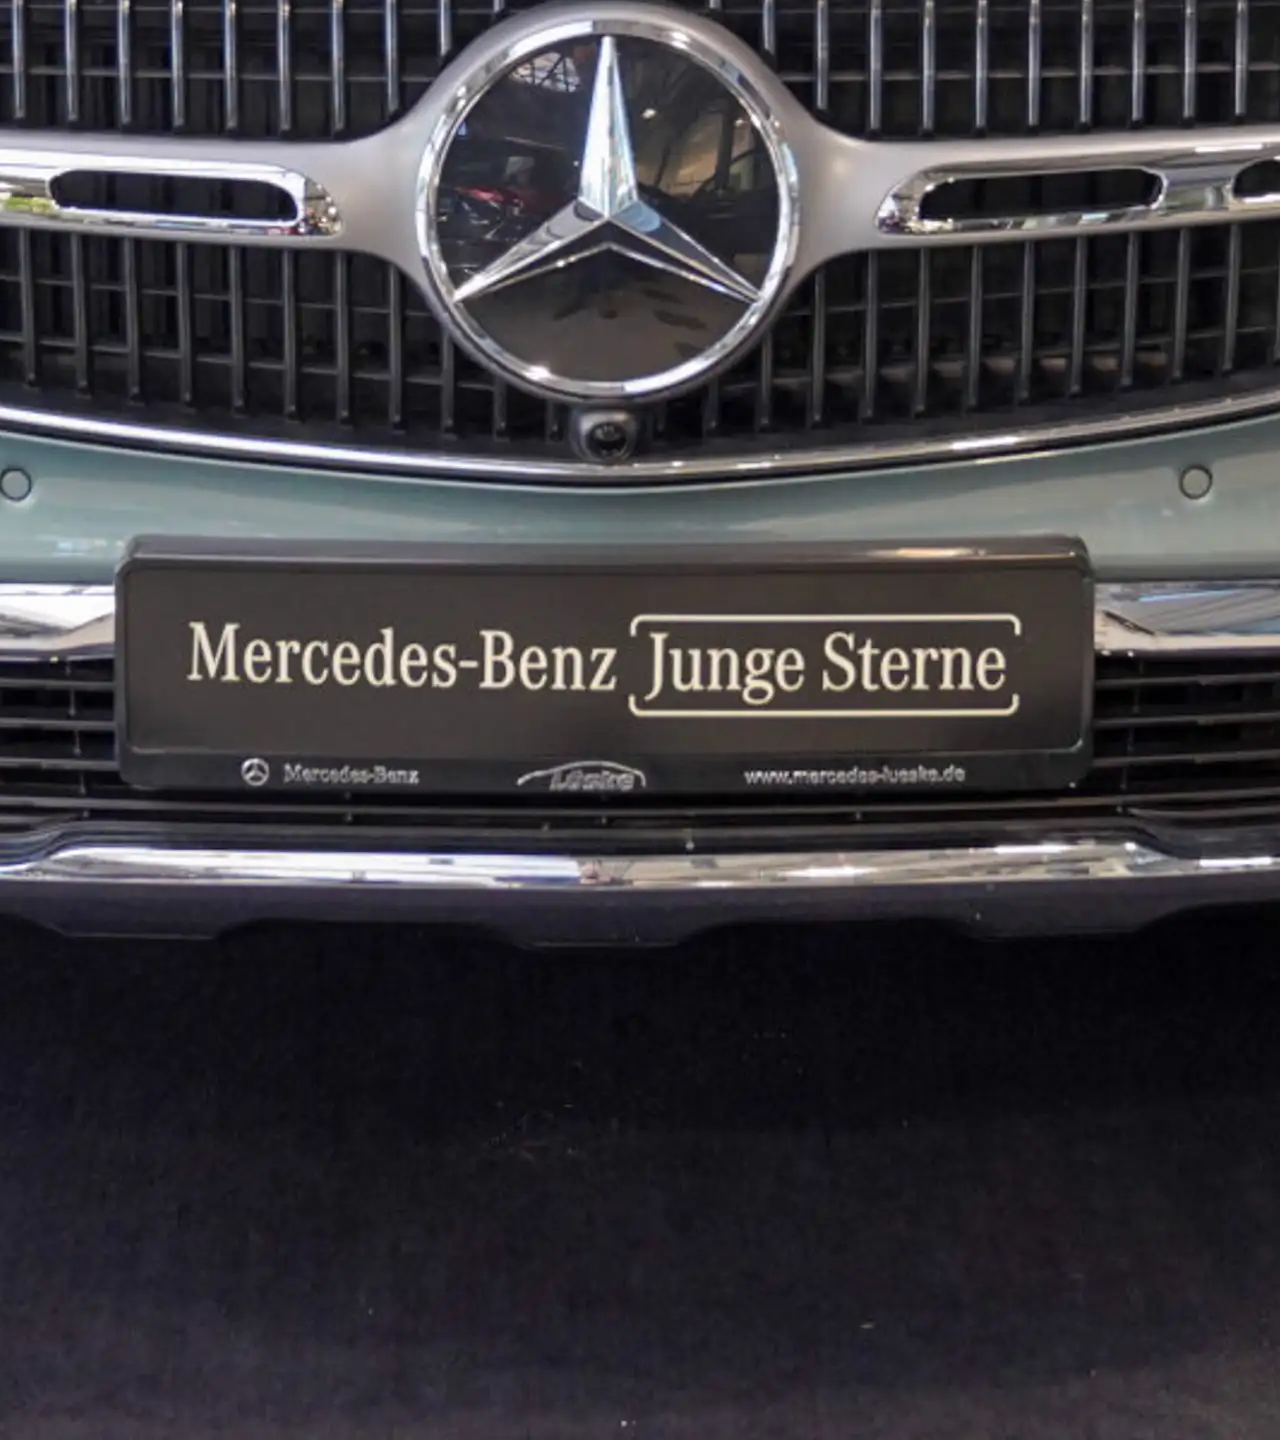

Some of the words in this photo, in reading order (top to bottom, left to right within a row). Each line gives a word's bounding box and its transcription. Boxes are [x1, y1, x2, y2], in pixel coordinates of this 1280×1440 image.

[186, 620, 618, 691] Mercedes-Benz
[643, 630, 806, 706] Junge
[821, 630, 1007, 692] Sterne
[282, 761, 421, 785] Mercedes-Benz
